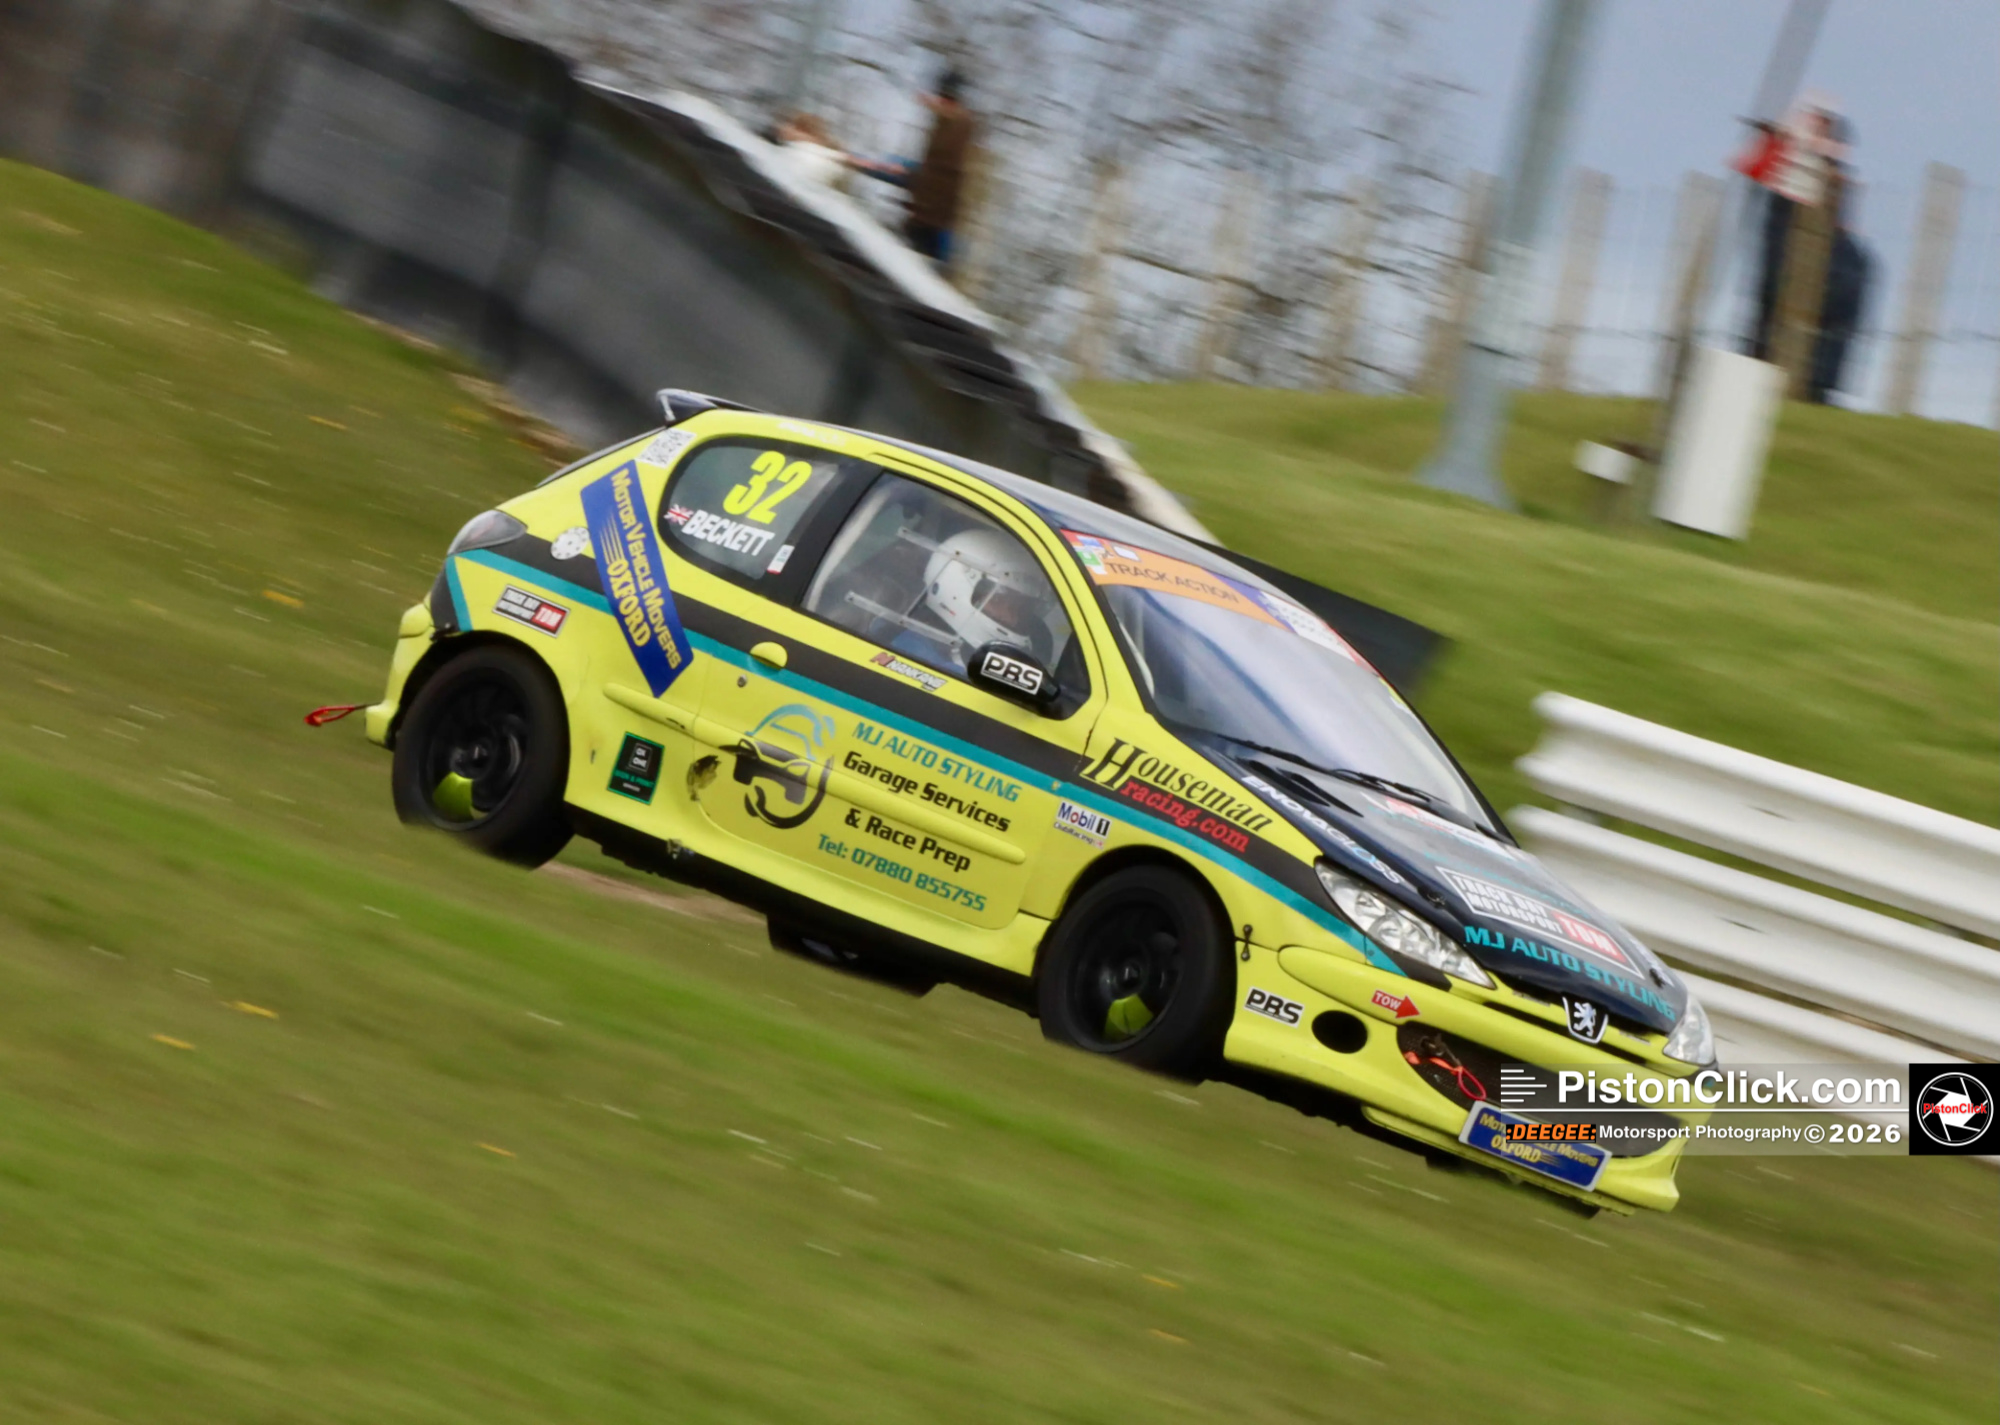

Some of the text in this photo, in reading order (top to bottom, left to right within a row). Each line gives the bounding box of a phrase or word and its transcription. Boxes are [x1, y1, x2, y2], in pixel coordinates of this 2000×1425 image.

[722, 450, 813, 525] 32
[681, 509, 776, 557] BECKETT
[606, 558, 651, 648] OXFORD
[1106, 562, 1240, 604] TRACK ACTION
[984, 654, 1042, 692] PRS
[852, 722, 1023, 803] MJ AUTO STYLING
[1083, 736, 1275, 833] Houseman
[843, 750, 1012, 833] Garage Services
[844, 807, 971, 873] & Race Prep
[1057, 802, 1097, 831] Mobil
[1119, 779, 1250, 854] racing.com
[817, 833, 988, 912] Tel: 07880 855755
[1452, 875, 1549, 918] TRACK DAY
[1465, 891, 1564, 935] MOTORSPORT
[1558, 915, 1619, 957] TDM
[1464, 925, 1677, 1022] MJ AUTO STYLING
[1246, 988, 1304, 1025] PRS
[1375, 992, 1402, 1010] TOW
[1490, 1134, 1543, 1164] OXFORD
